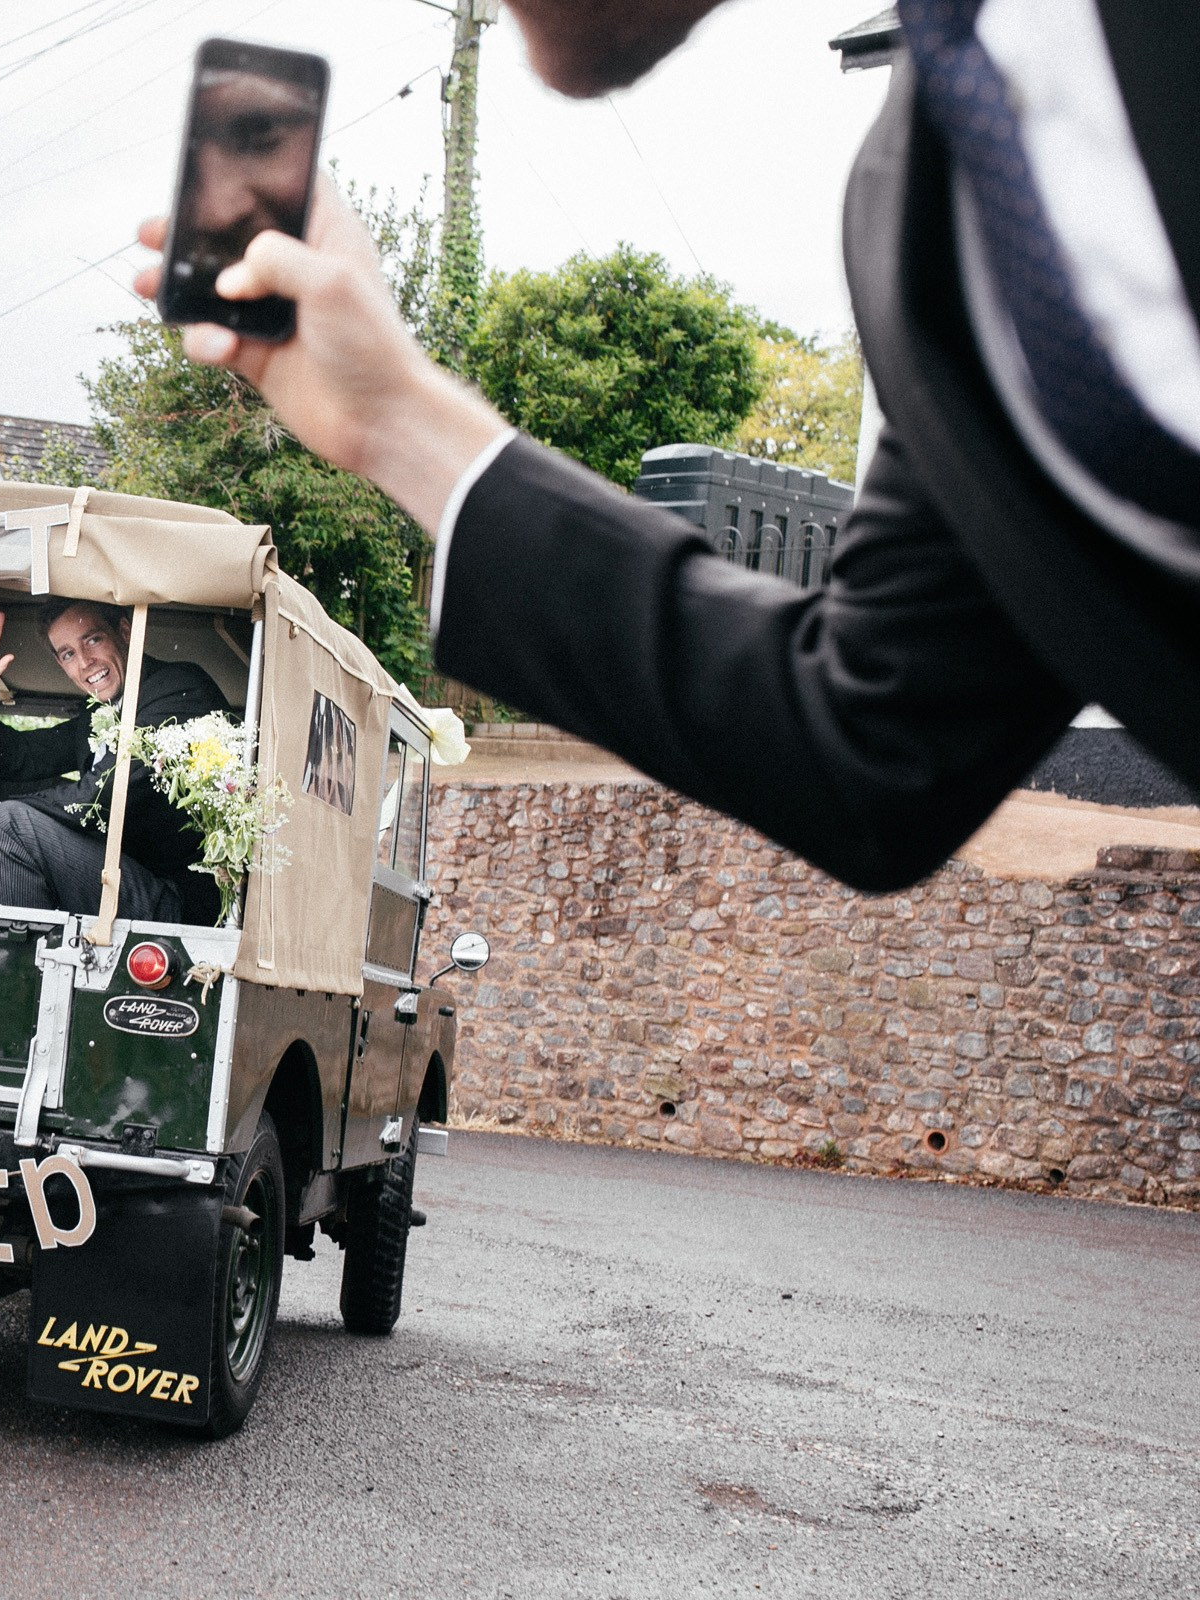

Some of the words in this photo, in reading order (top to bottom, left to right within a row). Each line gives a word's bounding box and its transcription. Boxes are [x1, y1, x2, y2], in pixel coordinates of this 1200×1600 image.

[119, 1001, 157, 1015] LAND
[139, 1018, 184, 1033] ROVER
[37, 1316, 129, 1355] LAND
[81, 1359, 200, 1404] ROVER
